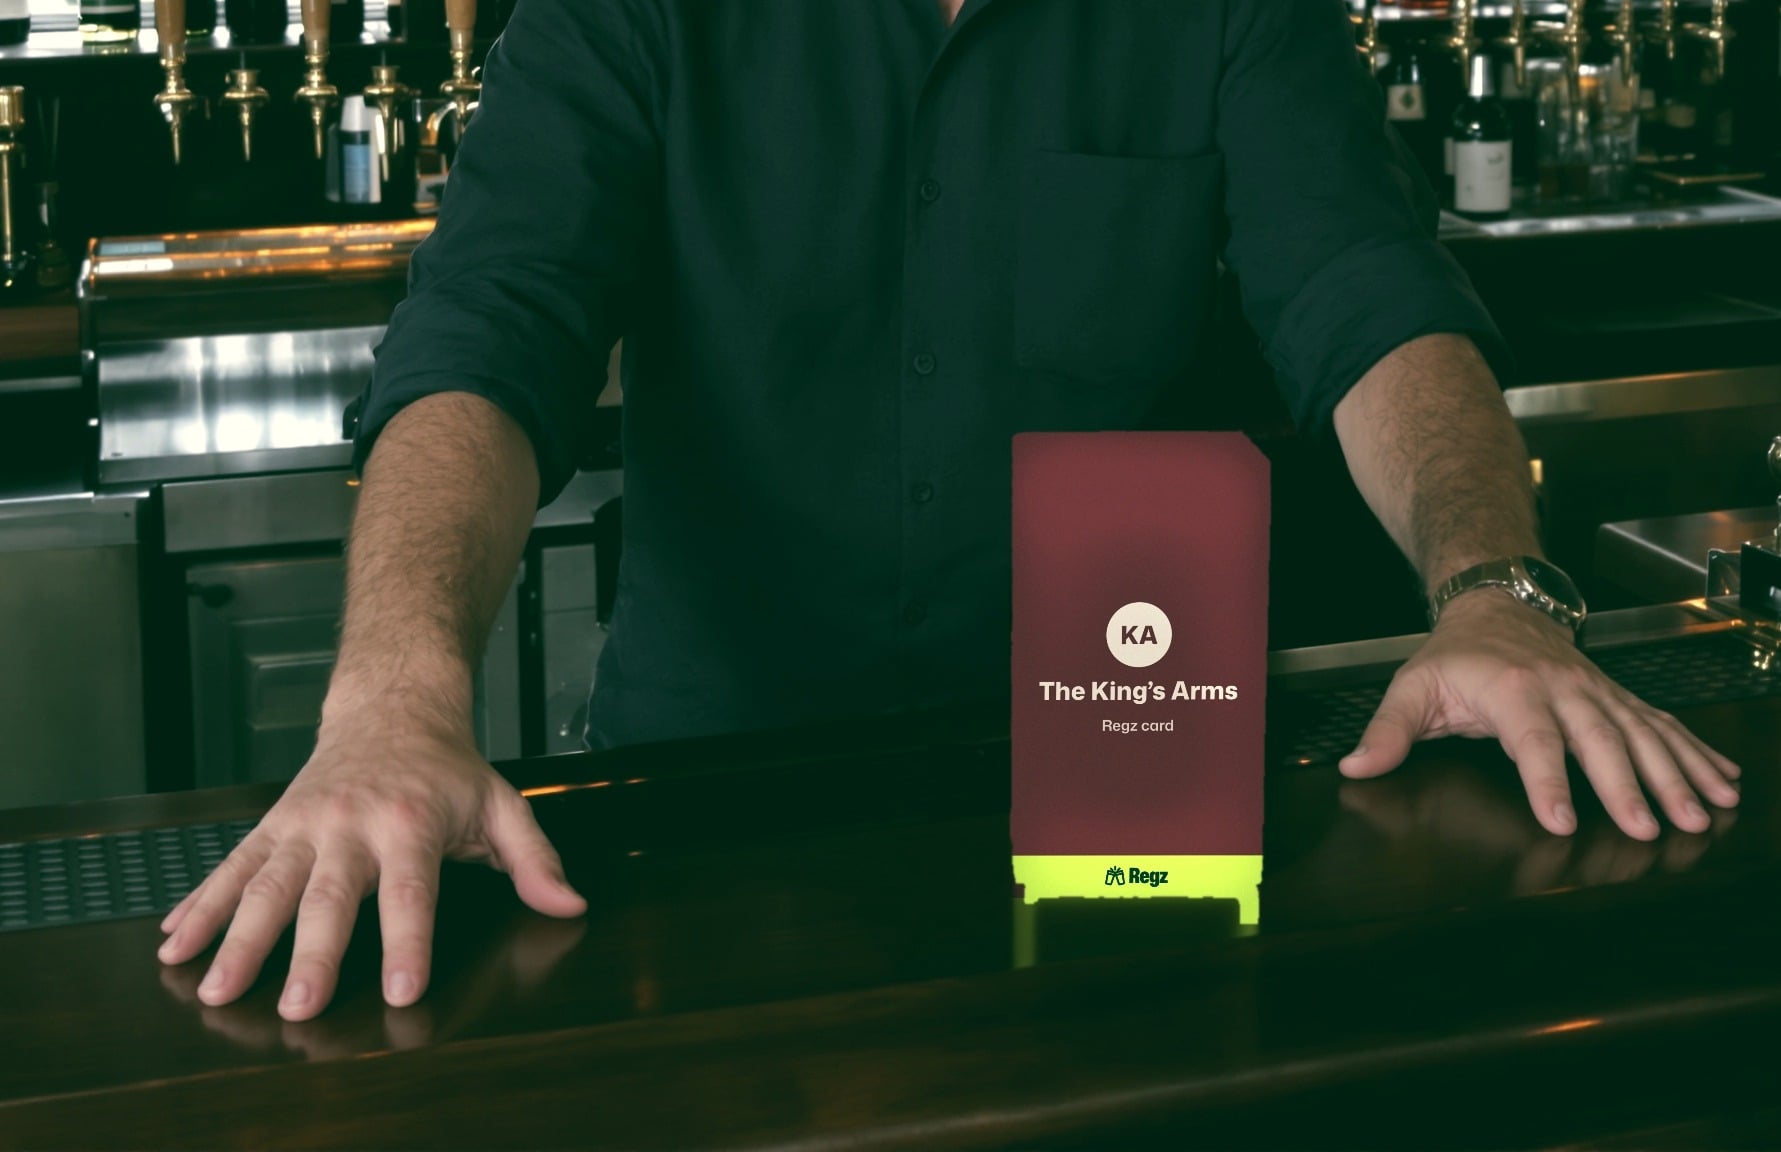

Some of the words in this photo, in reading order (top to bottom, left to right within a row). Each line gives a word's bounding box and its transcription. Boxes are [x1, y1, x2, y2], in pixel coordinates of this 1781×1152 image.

[1121, 625, 1158, 645] KA
[1039, 681, 1086, 701] The
[1092, 681, 1166, 705] King’s
[1171, 681, 1238, 701] Arms
[1102, 719, 1138, 734] Regz
[1142, 719, 1174, 733] card
[1129, 867, 1169, 888] Regz
